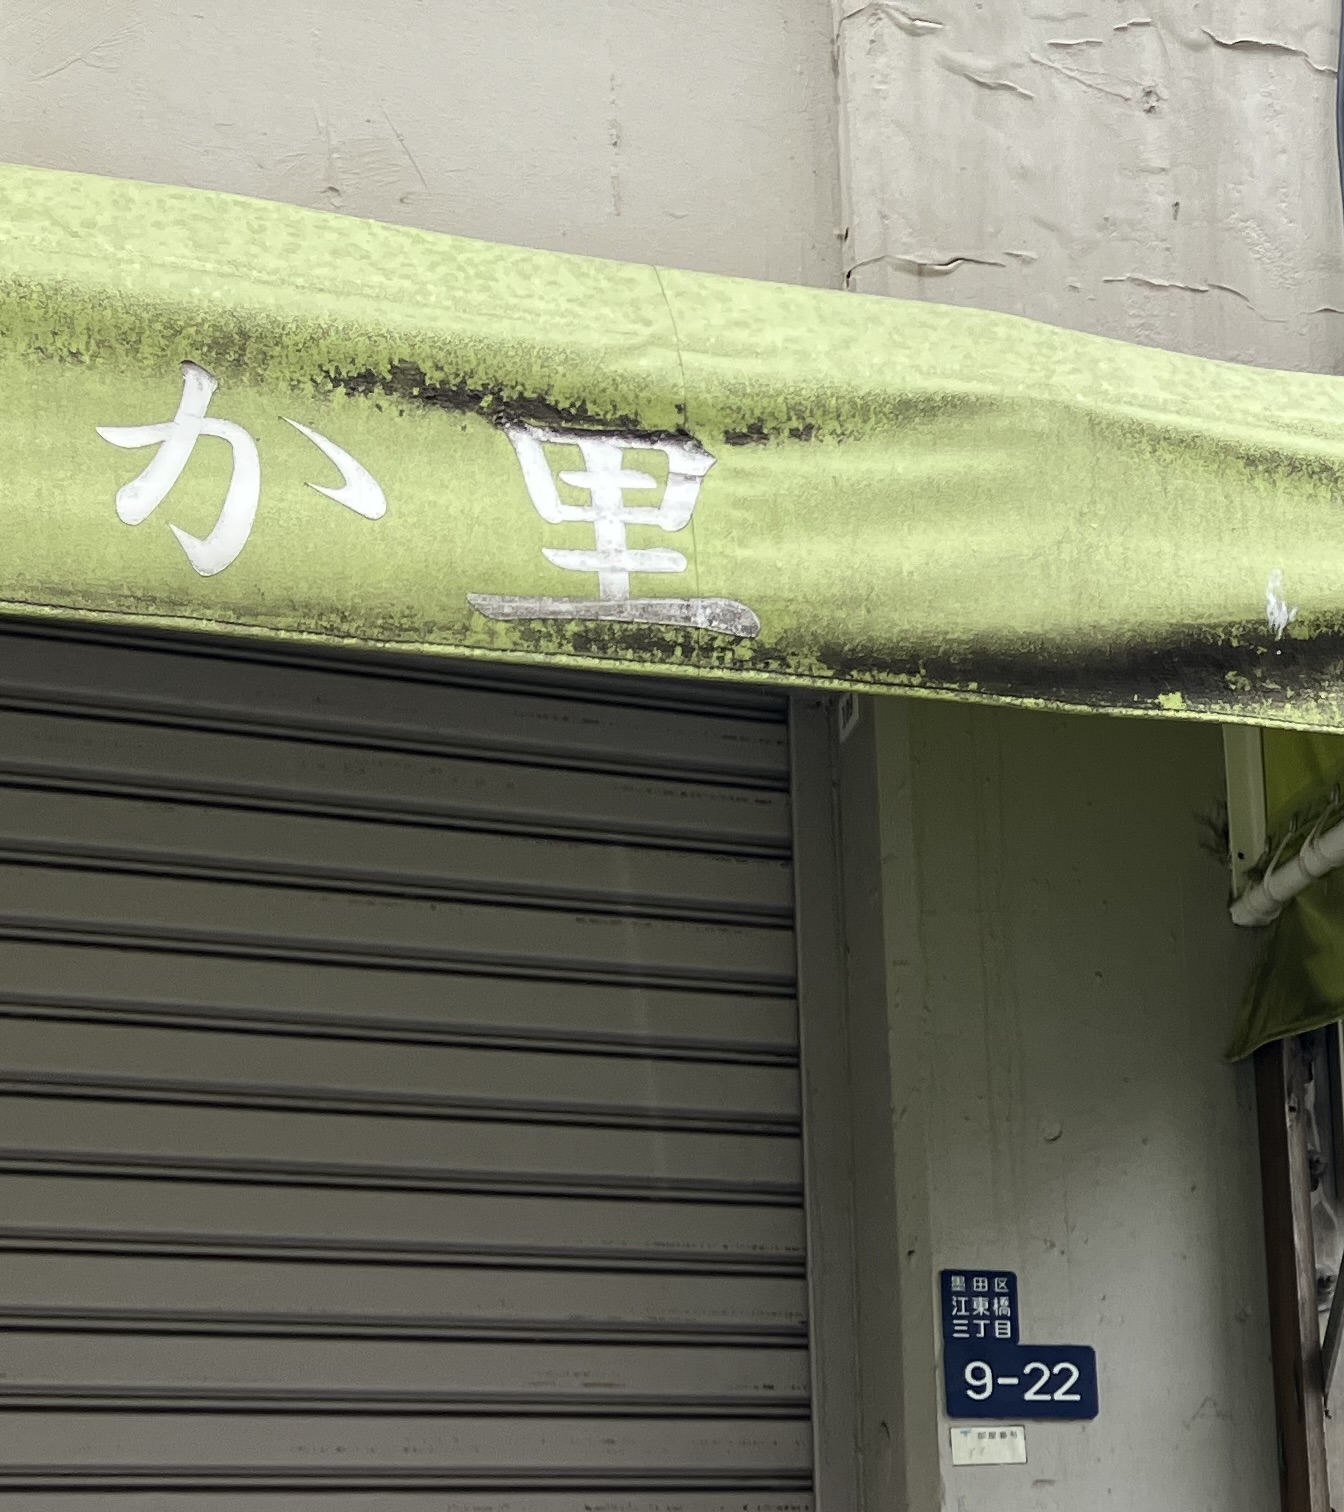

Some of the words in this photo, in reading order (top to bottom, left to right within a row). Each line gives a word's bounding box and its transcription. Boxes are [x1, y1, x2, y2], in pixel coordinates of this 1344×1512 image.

[951, 1275, 1009, 1292] 墨田区
[951, 1296, 1011, 1317] 江東橋
[952, 1319, 1012, 1339] 三丁目
[964, 1361, 1081, 1401] 9-22
